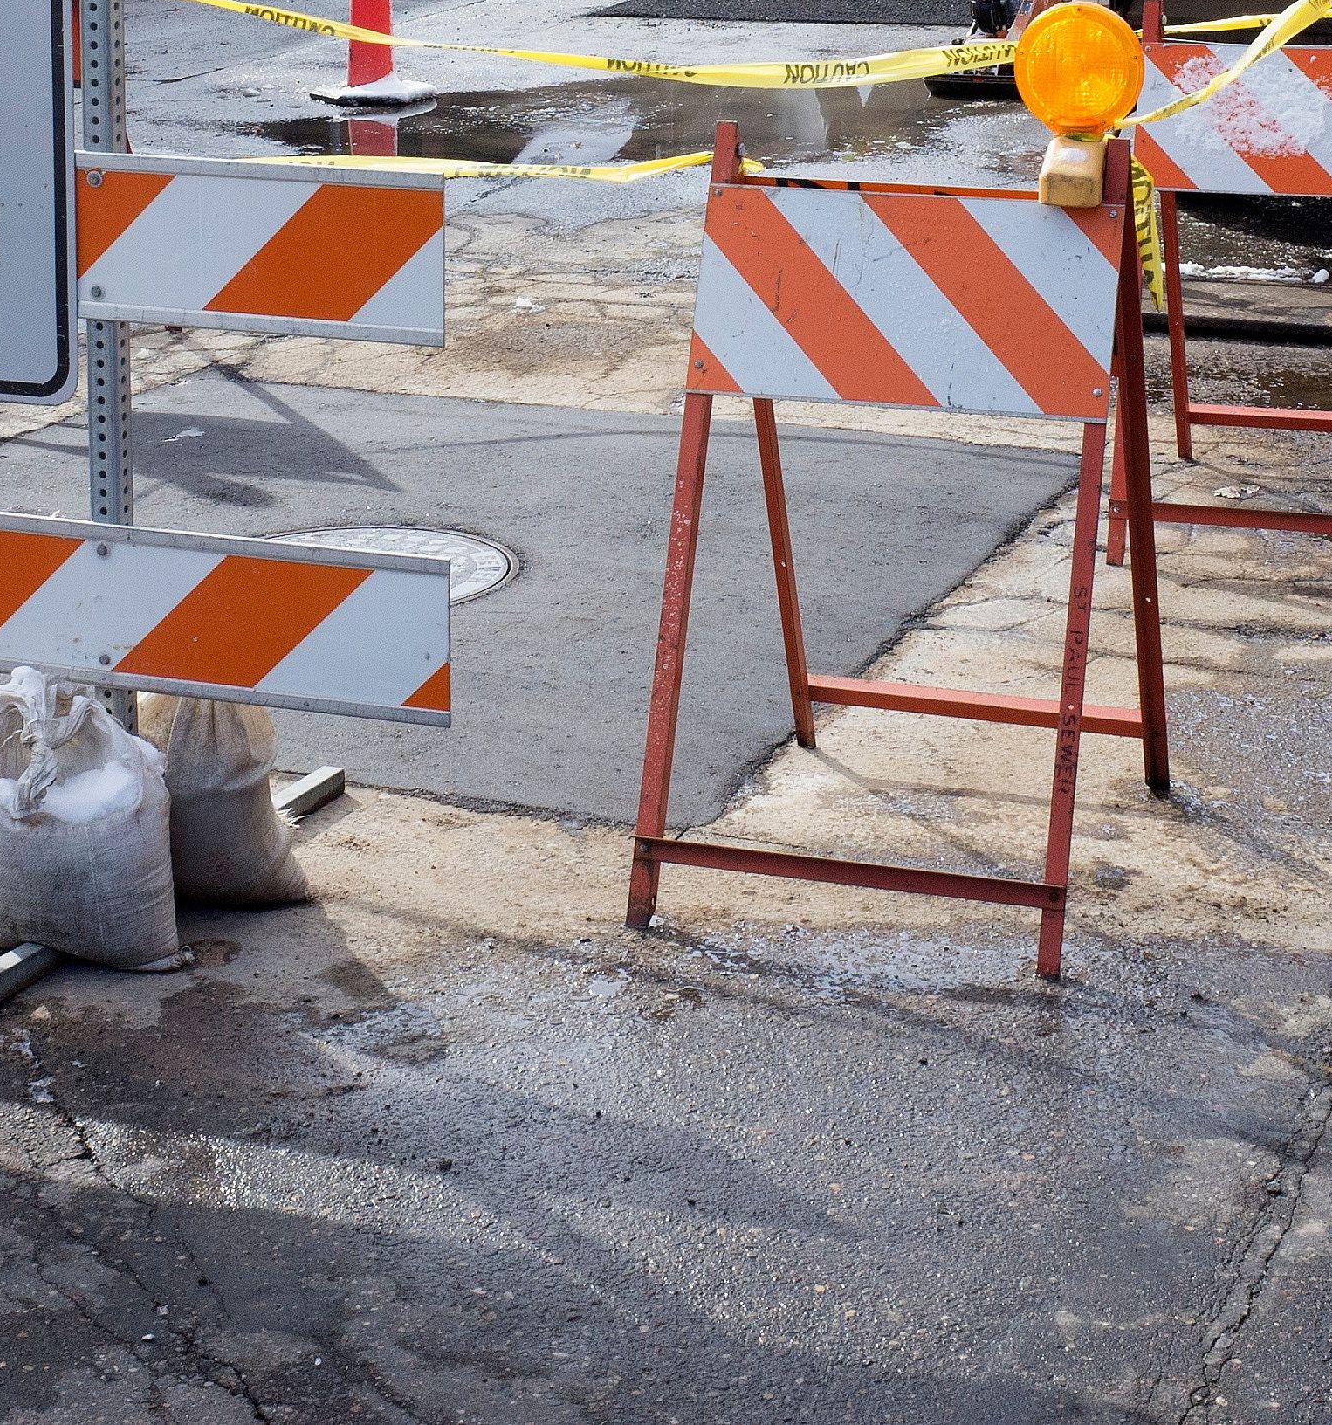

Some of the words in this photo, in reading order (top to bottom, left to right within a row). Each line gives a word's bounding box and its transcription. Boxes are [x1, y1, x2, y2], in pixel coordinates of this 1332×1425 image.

[783, 60, 870, 84] CAUTION
[942, 44, 1017, 69] AUTION
[1064, 630, 1083, 693] PAUL
[1058, 713, 1077, 794] SEWER
